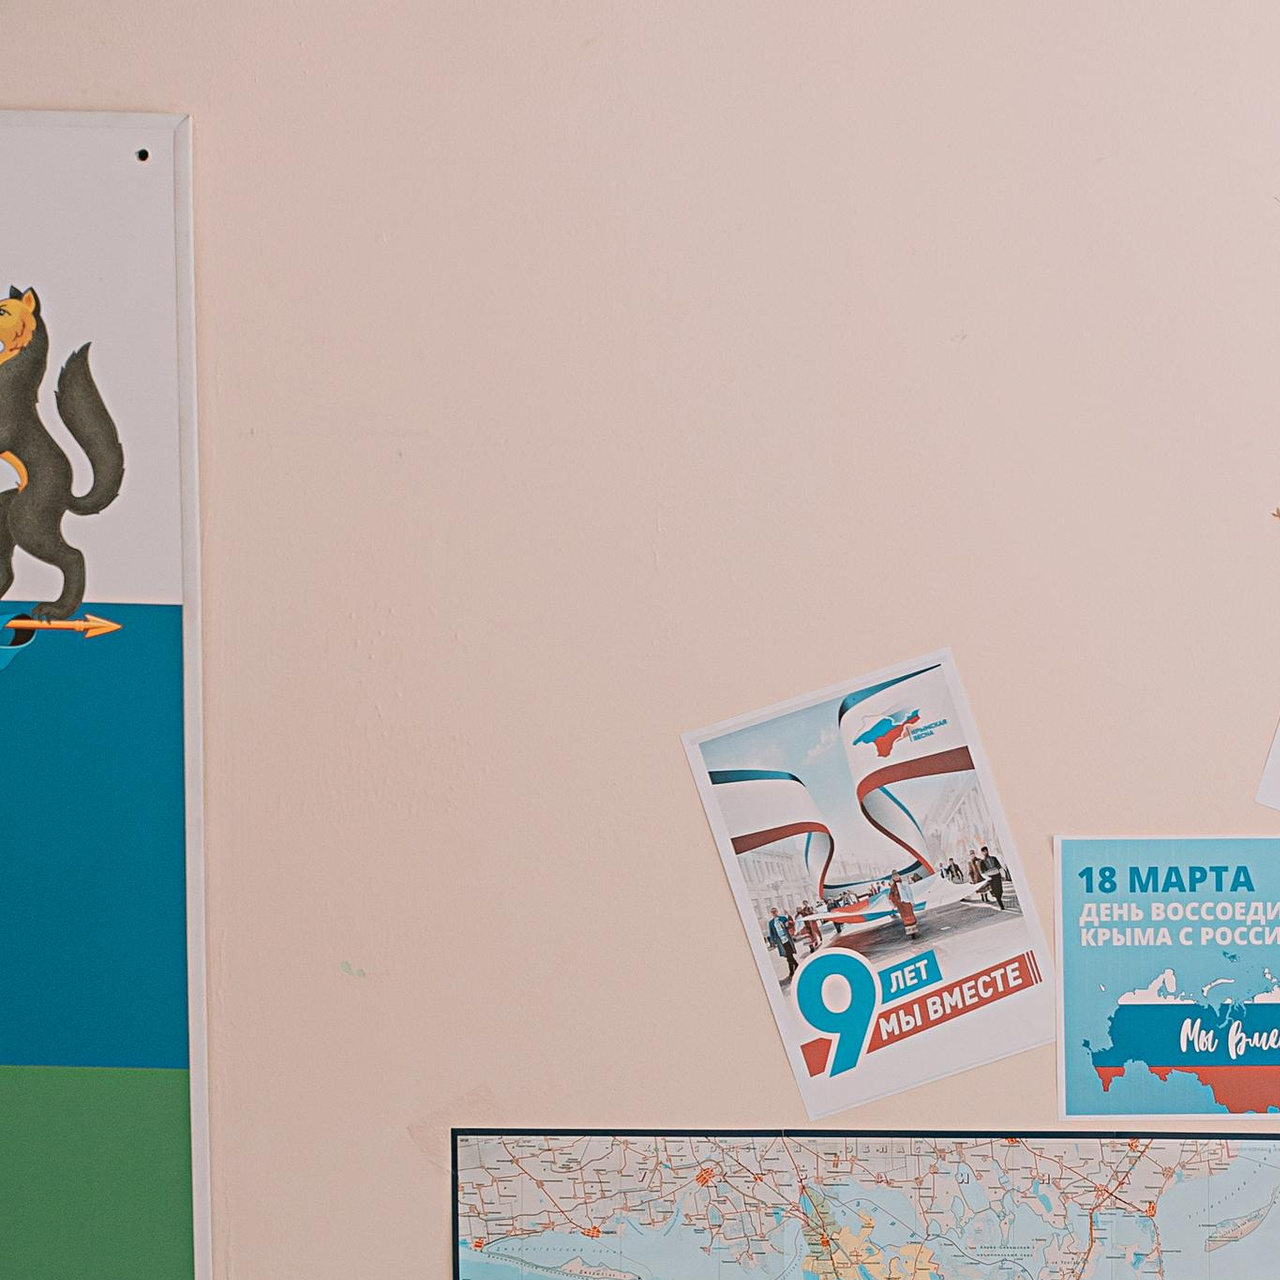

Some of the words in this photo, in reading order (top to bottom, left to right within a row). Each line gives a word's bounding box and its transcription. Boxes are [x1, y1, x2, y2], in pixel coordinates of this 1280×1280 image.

[1078, 866, 1117, 894] 18
[1129, 865, 1256, 893] МАРТА
[1079, 902, 1144, 927] ДЕНЬ
[1080, 927, 1173, 947] КРЫМА
[1179, 927, 1193, 946] С
[797, 953, 876, 1077] 9
[890, 960, 928, 993] ЛЕТ
[878, 1004, 923, 1040] МЫ
[926, 961, 1023, 1021] ВМЕСТЕ
[1180, 1017, 1218, 1053] Мы
